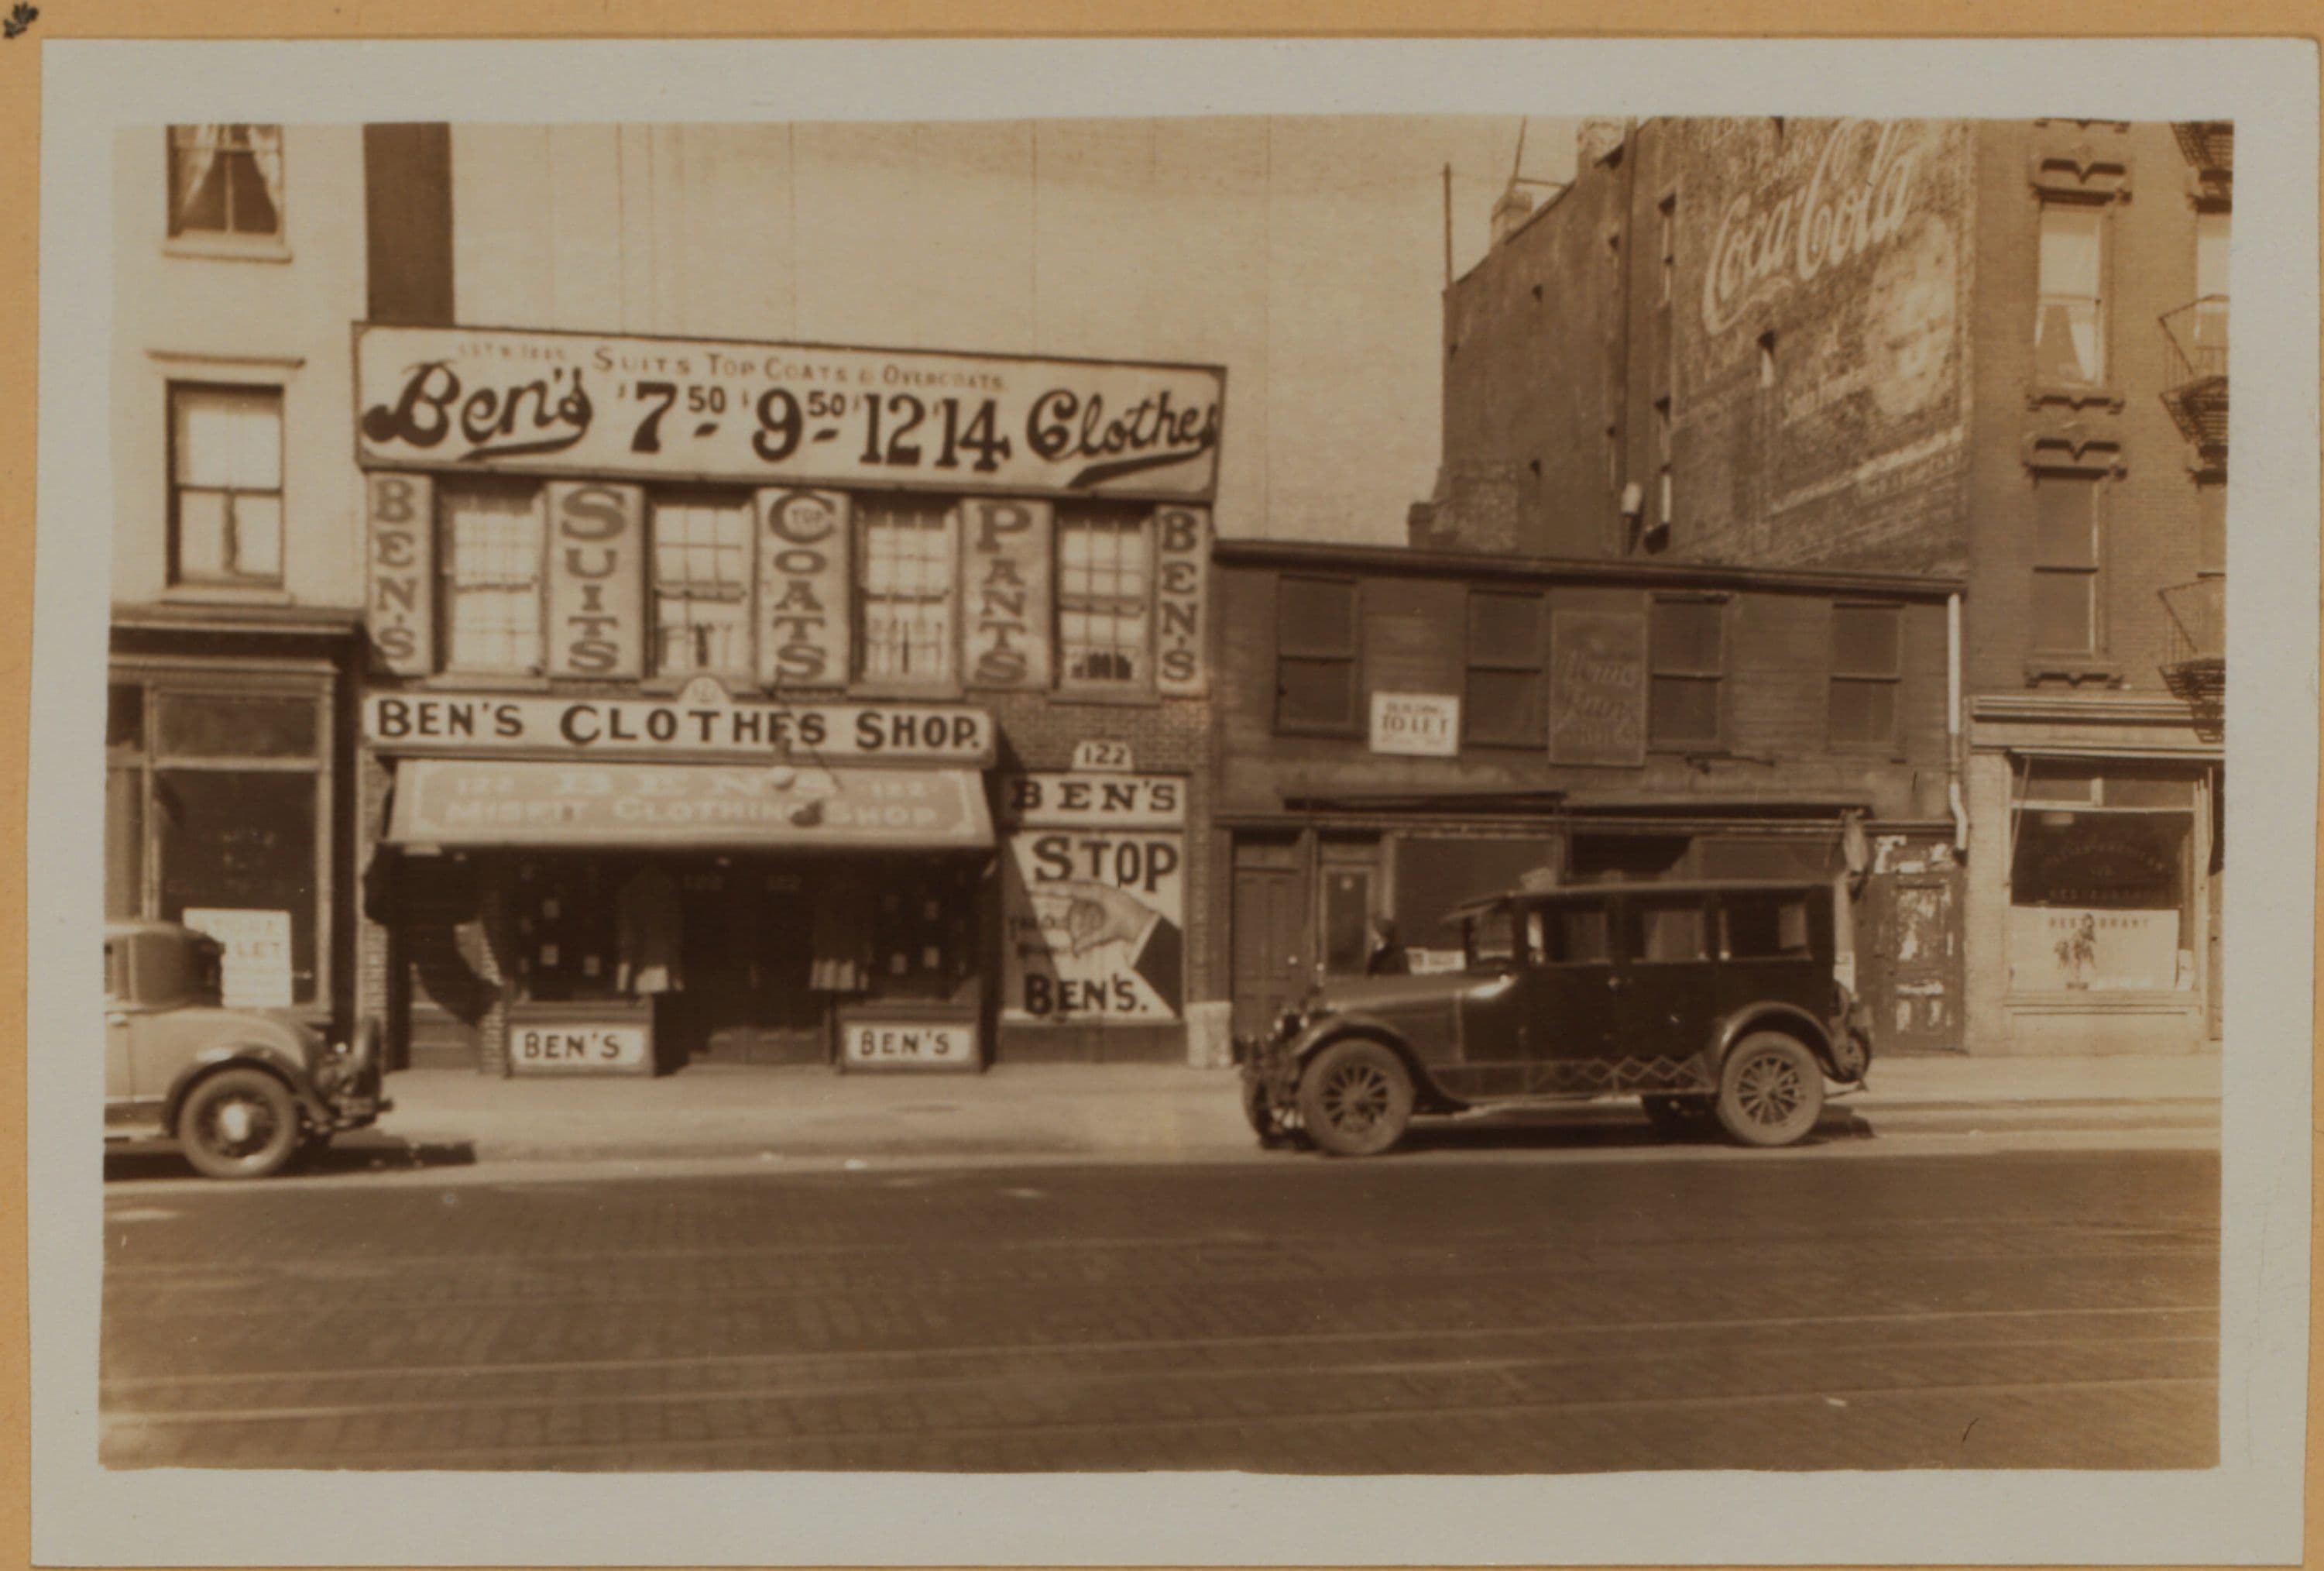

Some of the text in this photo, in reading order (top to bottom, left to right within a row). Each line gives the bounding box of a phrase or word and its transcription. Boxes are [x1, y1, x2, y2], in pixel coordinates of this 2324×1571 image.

[593, 345, 690, 375] SUITS
[705, 352, 755, 376] TOP
[764, 356, 848, 383] COATS
[362, 359, 592, 462] Ben's
[375, 479, 419, 661] BEN'S
[561, 487, 626, 673] SUITS
[769, 491, 836, 680] COATS
[976, 504, 1033, 684] PANTS
[1161, 510, 1199, 682] BEN'S
[377, 699, 981, 751] BEN'S CLOTHES SHOP.
[1382, 714, 1449, 734] TO LET
[1084, 744, 1128, 765] 122
[827, 802, 937, 826] SHOP
[1012, 779, 1176, 813] BEN'S
[1032, 836, 1179, 892] STOP
[1024, 972, 1148, 1015] BEN'S.
[523, 1032, 621, 1060] BEN'S
[860, 1030, 950, 1057] BEN'S
